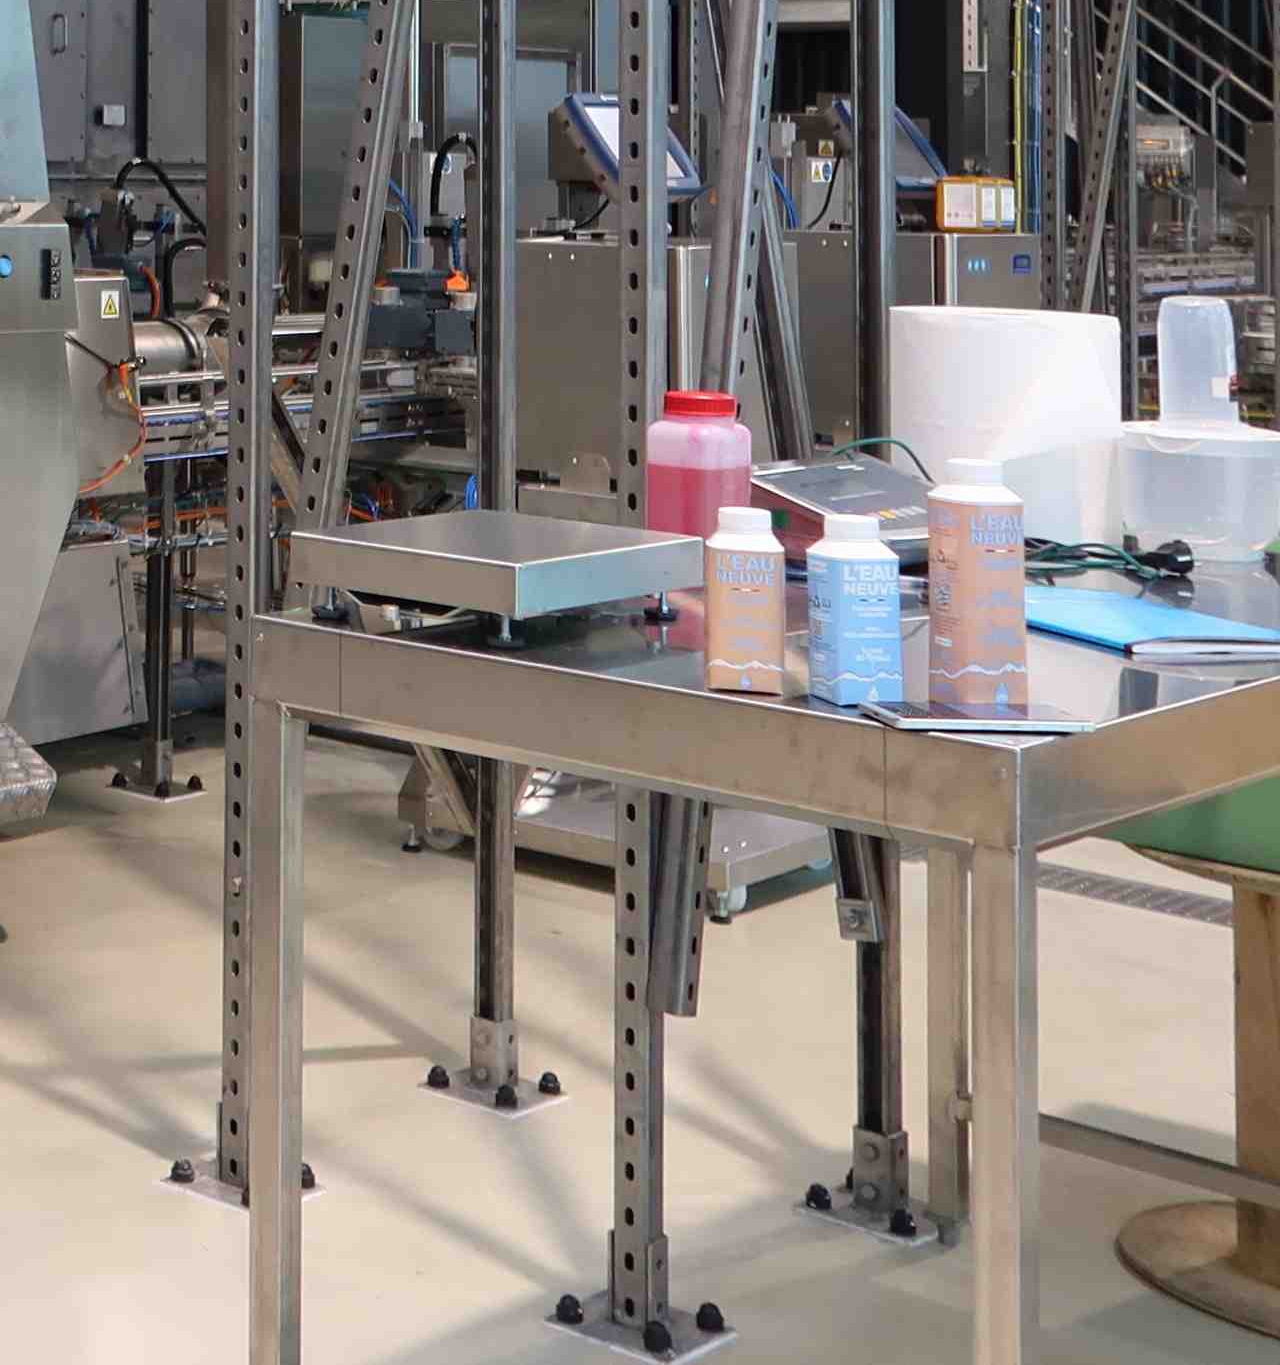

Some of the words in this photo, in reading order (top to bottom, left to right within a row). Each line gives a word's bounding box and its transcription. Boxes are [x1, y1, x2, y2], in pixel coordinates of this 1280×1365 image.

[716, 554, 776, 572] L'EAU
[717, 570, 776, 587] NEUVE
[843, 564, 898, 581] L'EAU
